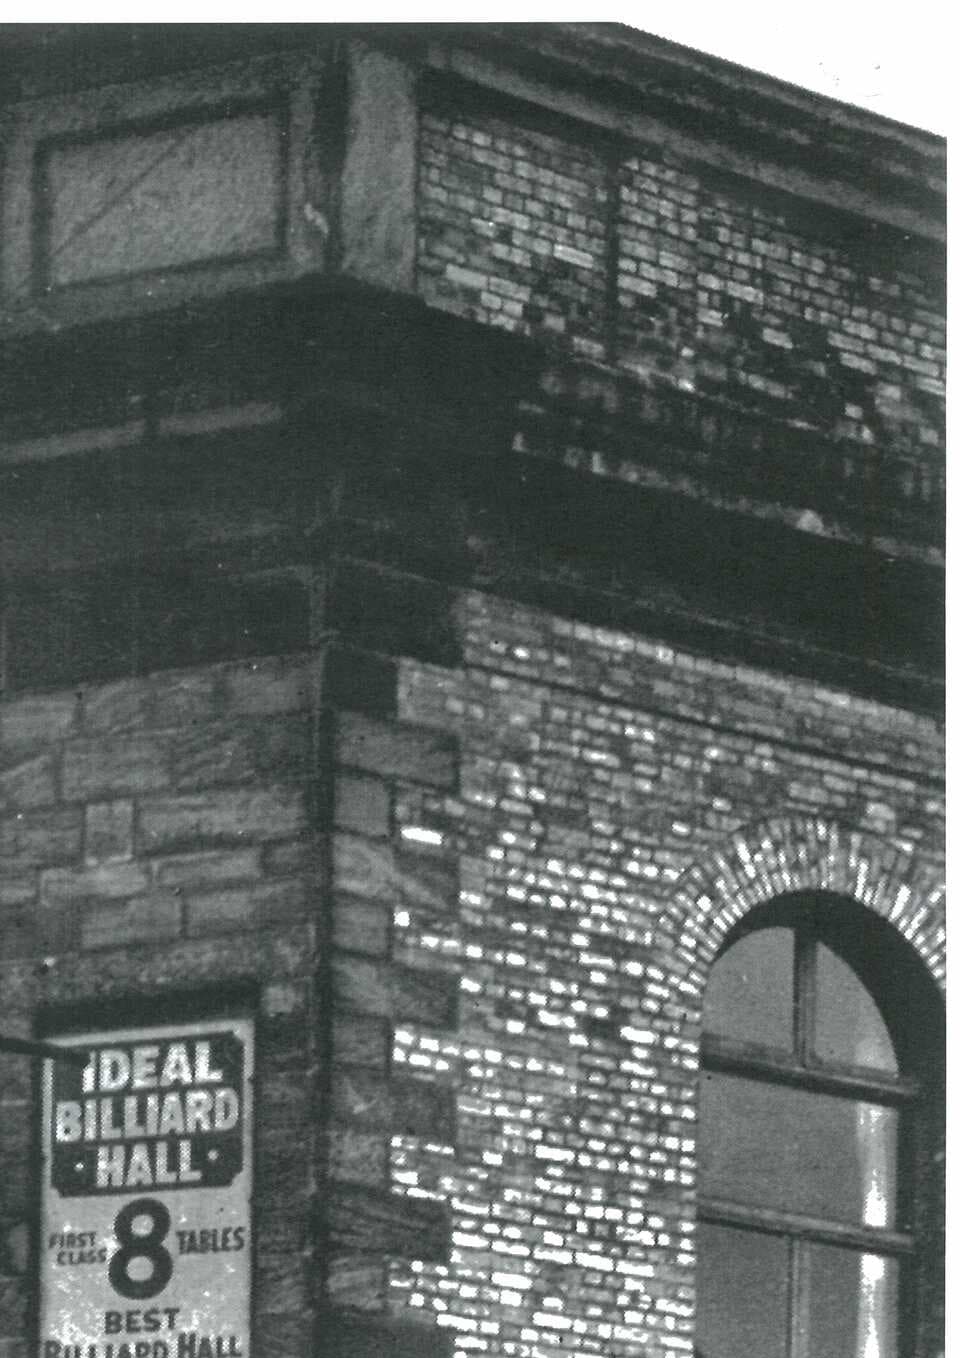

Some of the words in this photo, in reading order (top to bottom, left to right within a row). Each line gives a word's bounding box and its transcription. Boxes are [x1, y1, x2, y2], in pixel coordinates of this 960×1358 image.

[82, 1041, 224, 1094] IDEAL
[55, 1088, 239, 1142] BILLIARD
[96, 1139, 203, 1188] HALL
[48, 1231, 97, 1249] FIRST
[57, 1248, 108, 1266] CLASS
[108, 1197, 173, 1300] 8
[176, 1226, 246, 1255] TABLES
[105, 1307, 179, 1335] BEST
